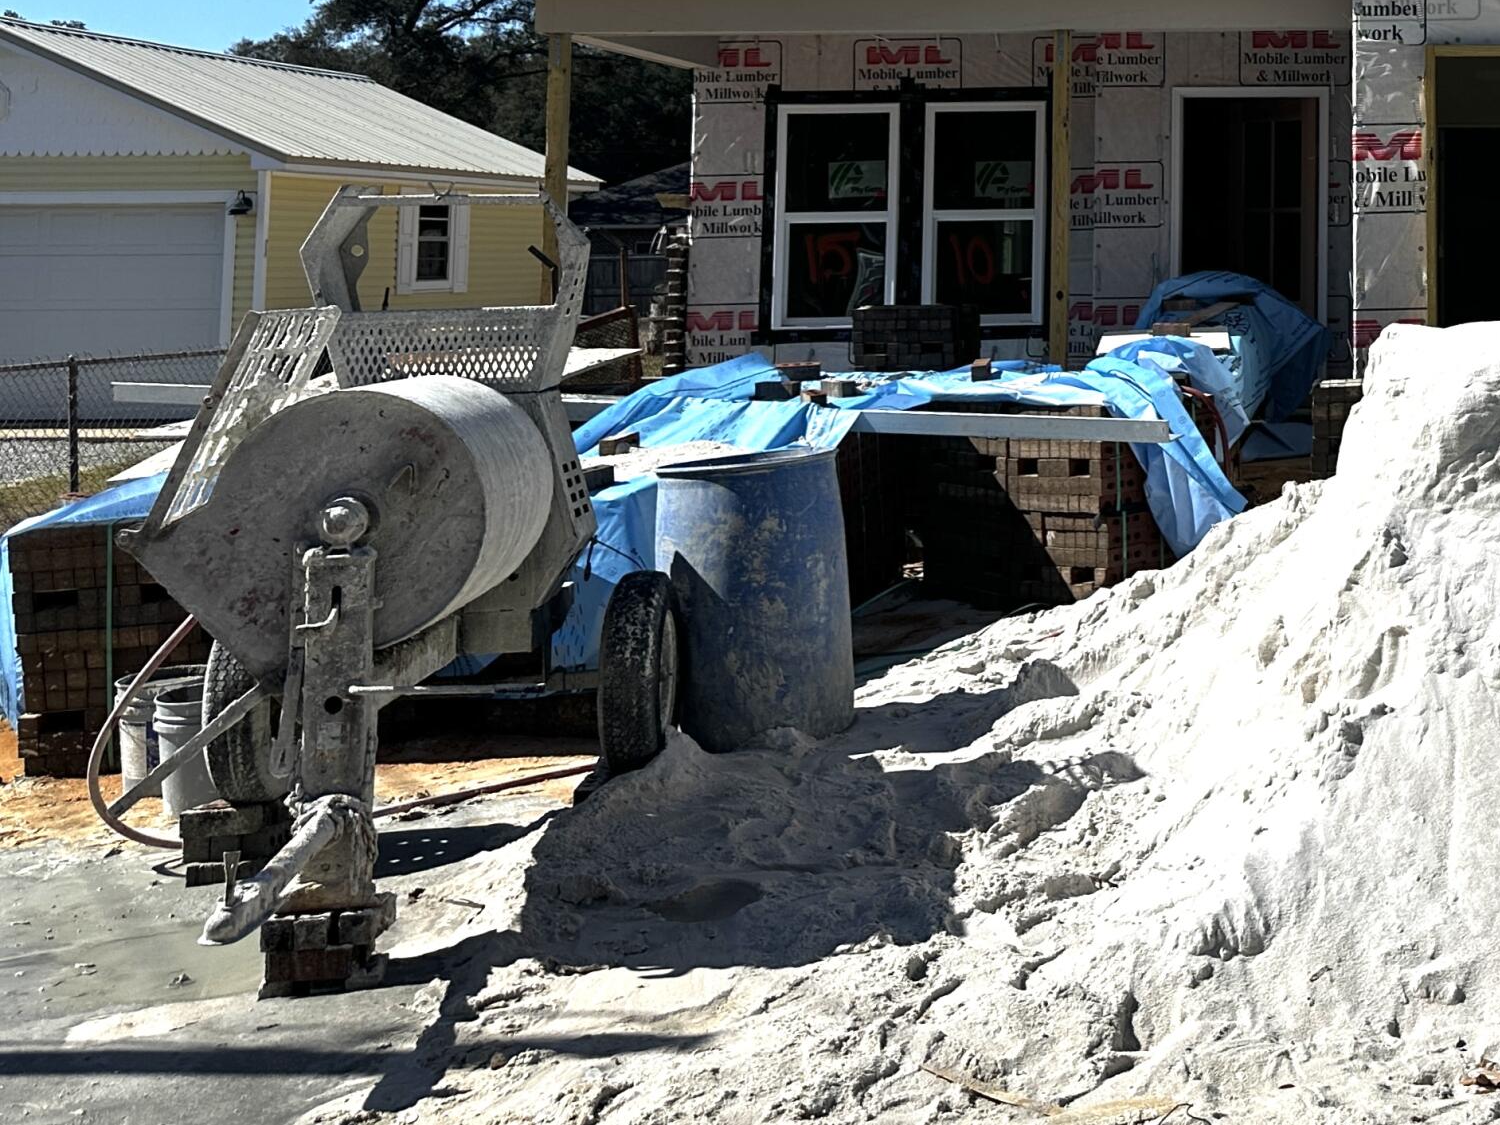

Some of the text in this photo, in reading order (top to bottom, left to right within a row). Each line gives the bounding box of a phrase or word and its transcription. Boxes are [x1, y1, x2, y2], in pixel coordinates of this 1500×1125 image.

[1252, 30, 1341, 49] ML
[867, 45, 952, 65] ML
[1108, 53, 1160, 65] Lumber
[1244, 52, 1347, 64] Mobile Lumber
[725, 71, 778, 82] Lumber
[859, 68, 903, 81] Mobile
[1256, 70, 1268, 82] &
[705, 88, 764, 100] Millwok
[1105, 194, 1160, 206] Lumber
